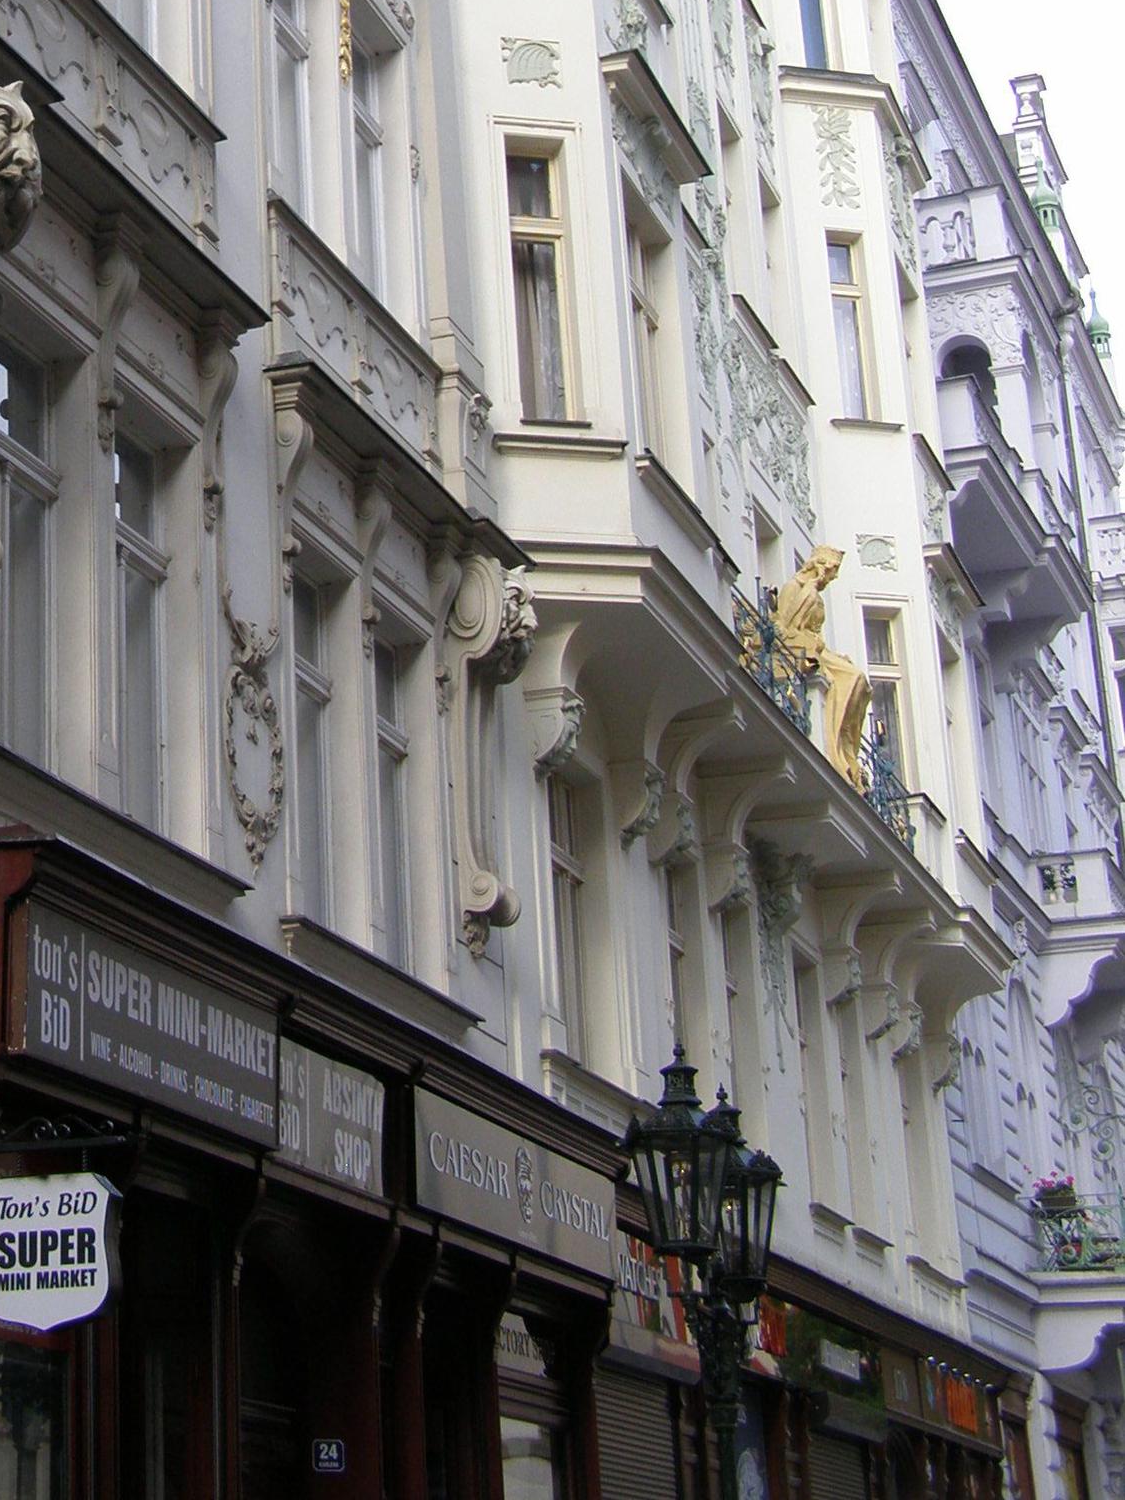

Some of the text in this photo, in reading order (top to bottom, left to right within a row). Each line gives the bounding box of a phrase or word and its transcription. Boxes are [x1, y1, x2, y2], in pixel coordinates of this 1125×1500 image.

[33, 924, 78, 992] ton's
[40, 988, 70, 1052] BiD
[87, 949, 277, 1080] SUPER MINI-MARKET
[90, 1031, 111, 1063] WINE
[118, 1043, 153, 1080] ALCOHOL
[160, 1059, 189, 1094] DRINKS
[194, 1074, 234, 1112] CHOCOLATE
[279, 1099, 300, 1151] BiD
[332, 1121, 371, 1182] SHOP
[430, 1131, 511, 1199] CAESAR
[57, 1190, 97, 1216] BiD
[540, 1180, 610, 1241] CRYSTAL
[36, 1268, 97, 1290] MARKET
[319, 1443, 338, 1460] 24
